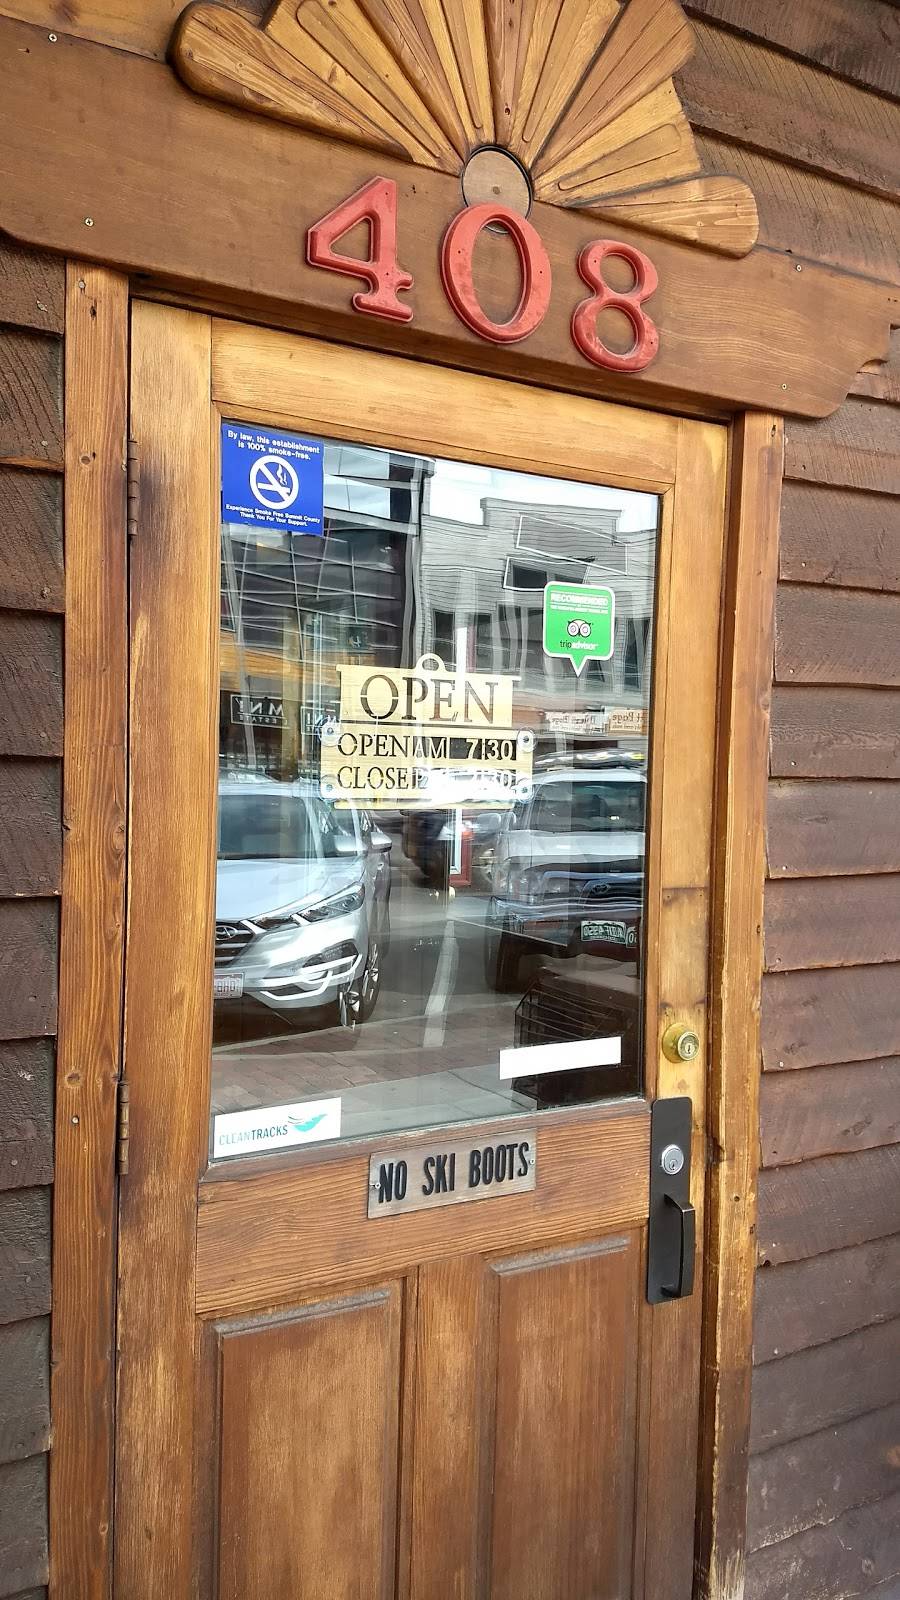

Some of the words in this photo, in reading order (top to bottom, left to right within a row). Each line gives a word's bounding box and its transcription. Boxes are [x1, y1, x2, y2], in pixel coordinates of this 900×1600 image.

[307, 176, 659, 373] 408
[227, 430, 237, 439] By
[240, 432, 254, 442] law,
[256, 436, 270, 444] this
[271, 439, 320, 453] establishment
[247, 442, 266, 452] 100%
[268, 448, 311, 460] smoke-free.
[225, 504, 253, 513] Experience
[255, 508, 271, 516] Smoke
[288, 519, 308, 527] Support.
[360, 674, 498, 724] OPEN
[338, 733, 412, 758] OPEN
[413, 736, 447, 759] AM
[466, 738, 514, 760] 7:30
[338, 766, 409, 789] CLOSE
[379, 1160, 408, 1203] NO
[422, 1153, 456, 1196] SKI
[469, 1142, 530, 1188] BOOTS
